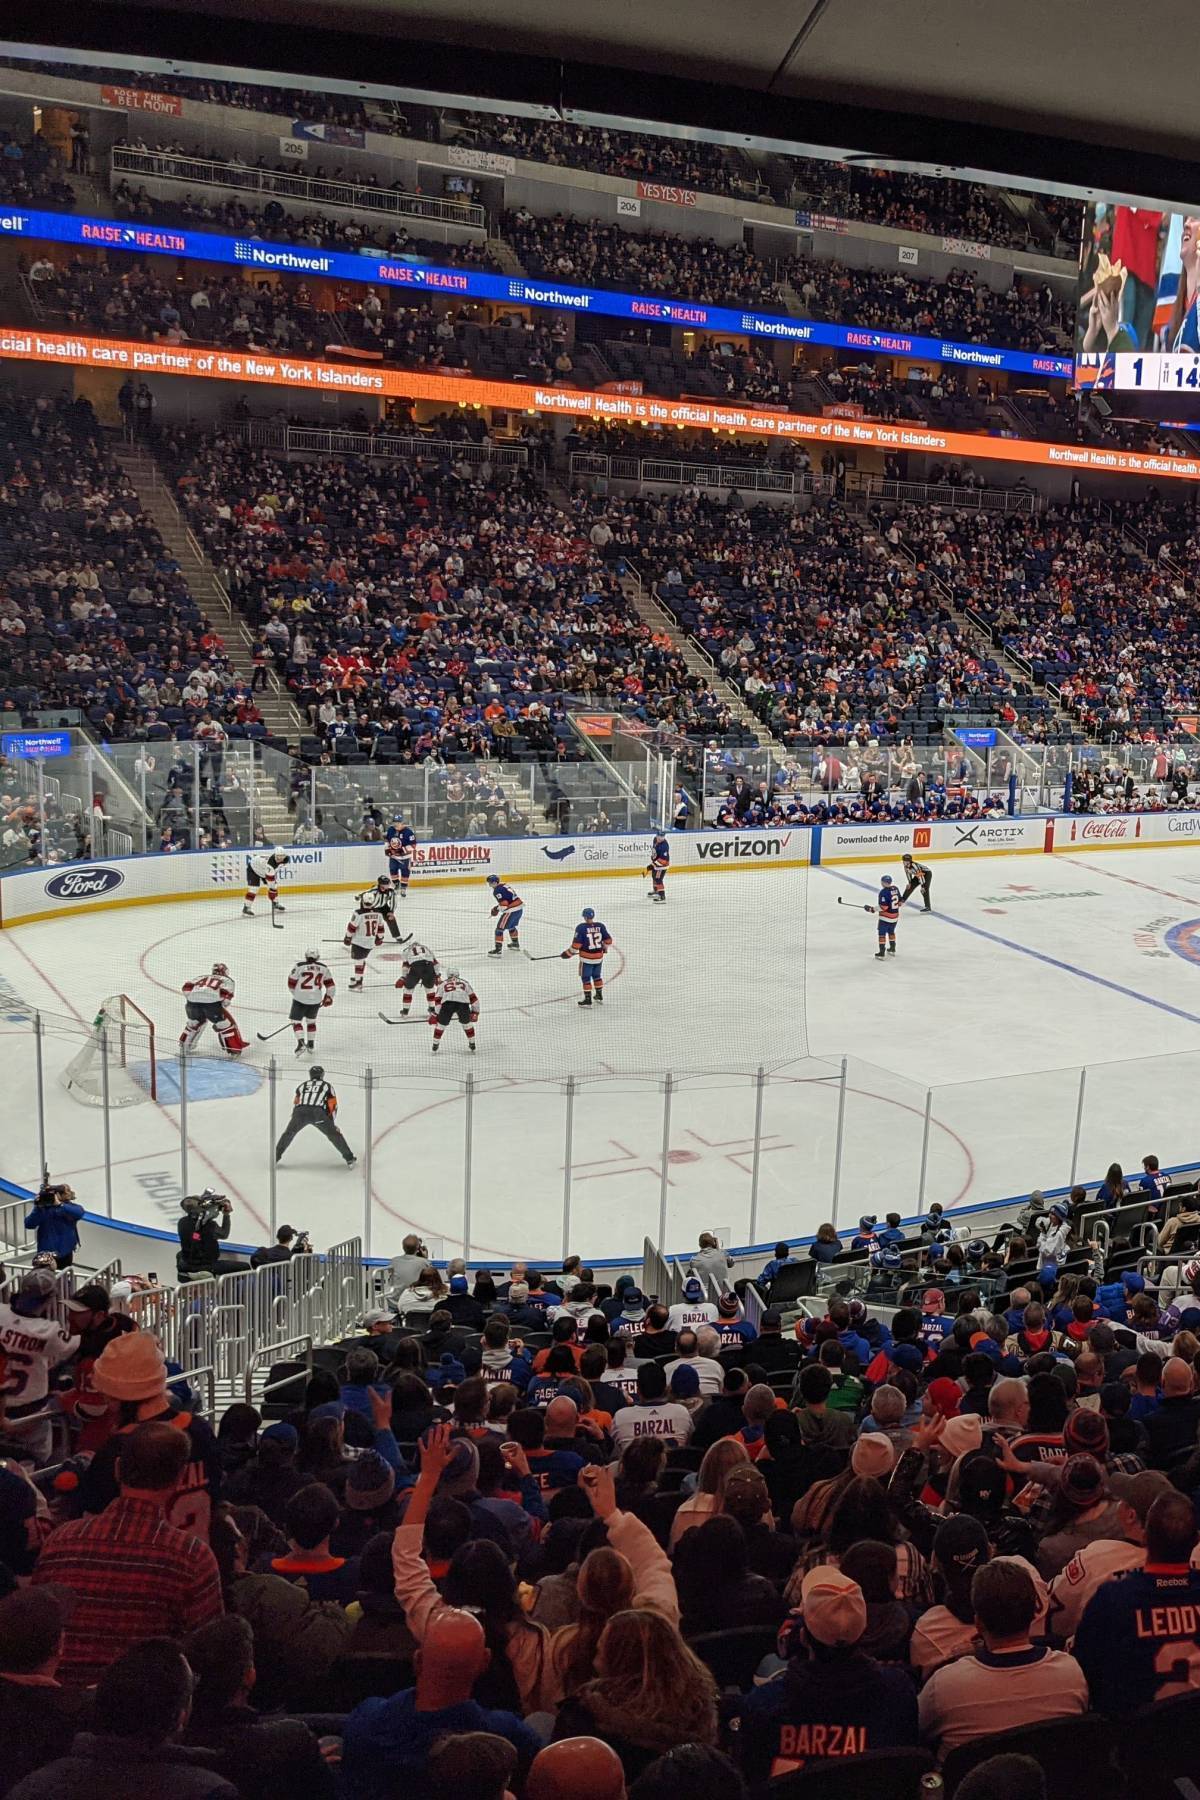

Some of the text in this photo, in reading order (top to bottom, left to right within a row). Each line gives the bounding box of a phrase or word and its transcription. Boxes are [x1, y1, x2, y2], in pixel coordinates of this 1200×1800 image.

[118, 95, 176, 115] BELMONT
[284, 143, 303, 155] 205
[620, 201, 637, 212] 206
[82, 224, 185, 250] RAISE HEALTH
[253, 249, 329, 272] Northwell
[902, 251, 915, 260] 207
[379, 265, 467, 289] RAISE HEALTH
[524, 287, 589, 308] Northwell
[632, 302, 707, 323] RAISE HEALTH
[755, 320, 810, 338] Northwell
[847, 332, 911, 352] RAISE HEALTH
[36, 338, 87, 358] health
[92, 347, 128, 362] care
[133, 351, 192, 368] partner
[197, 356, 214, 369] of
[218, 358, 241, 373] the
[246, 360, 275, 377] New
[280, 364, 312, 381] York
[317, 368, 383, 388] Islanders
[953, 348, 1001, 365] Northwell
[1033, 359, 1055, 373] RAISE
[1132, 358, 1144, 386] 1
[535, 392, 946, 447] Northwell Health is the official health care partner of the New York Islanders
[1049, 448, 1088, 462] Northwell
[1091, 453, 1116, 465] Health
[1119, 456, 1127, 467] is
[1129, 457, 1142, 468] the
[1144, 459, 1171, 471] official
[1173, 462, 1197, 473] health
[837, 833, 910, 845] Download the App
[979, 827, 1024, 838] ARCTIX
[428, 845, 491, 861] Authority
[584, 849, 609, 861] Gale
[697, 837, 780, 859] verizon
[60, 871, 108, 895] Ford
[586, 932, 603, 949] 12
[301, 972, 323, 989] 24
[305, 1085, 319, 1093] 30
[682, 1312, 709, 1324] BARZAL
[633, 1419, 676, 1436] BARZAL
[1156, 1577, 1188, 1588] Reebok
[780, 1725, 868, 1757] BARZAL
